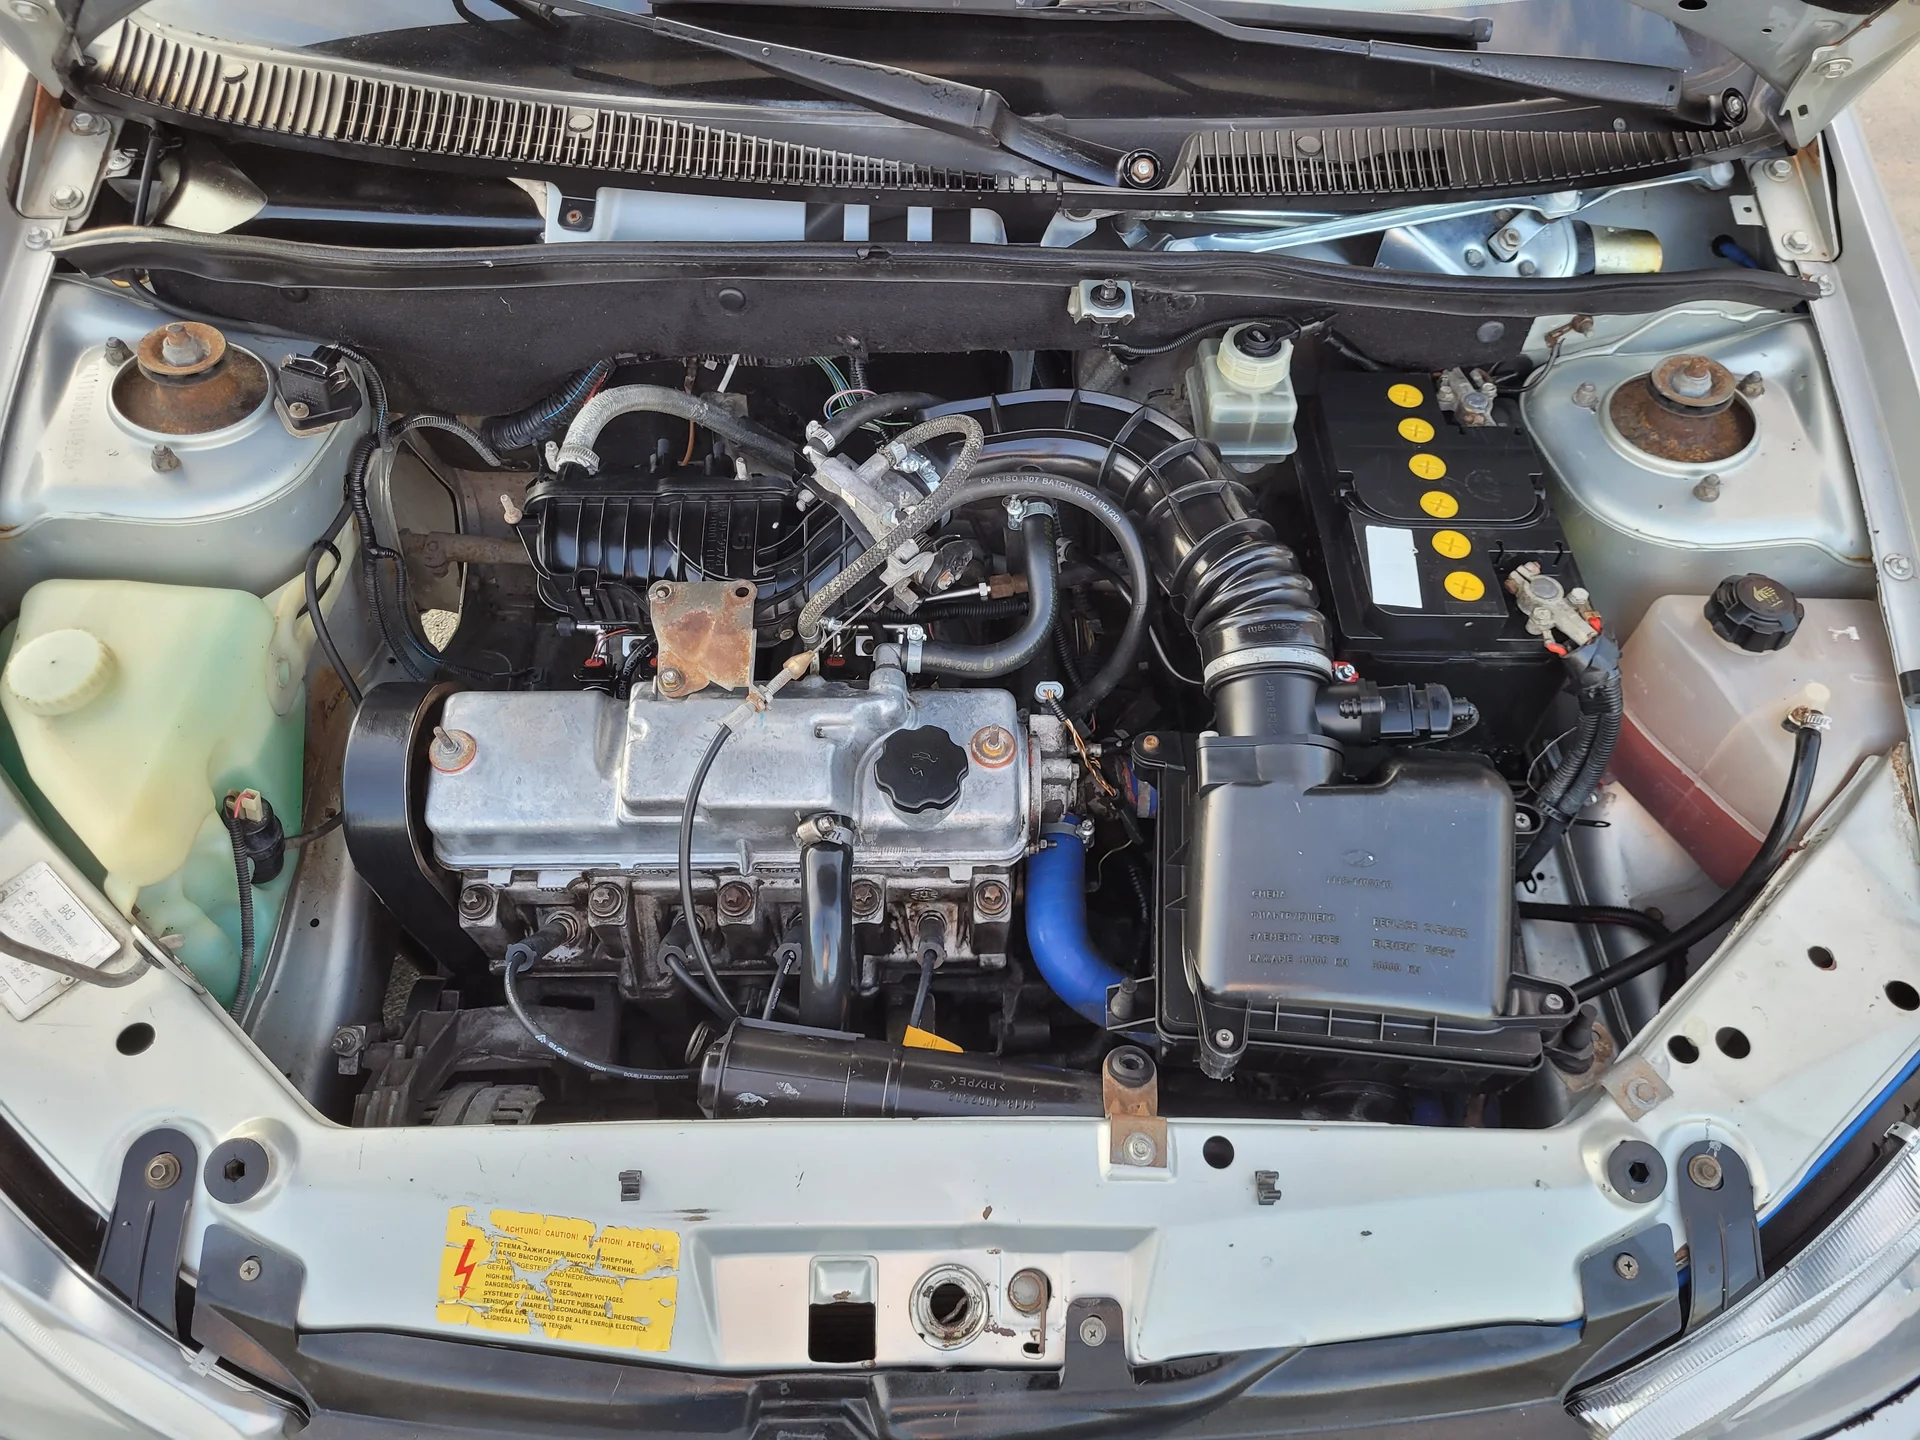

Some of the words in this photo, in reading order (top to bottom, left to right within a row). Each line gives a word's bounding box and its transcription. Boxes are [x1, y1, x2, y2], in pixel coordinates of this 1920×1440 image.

[1042, 477, 1073, 491] BATCH
[1074, 486, 1097, 501] 13027
[926, 656, 978, 671] 01.03.2024
[1251, 889, 1286, 899] СМЕНА
[1250, 911, 1336, 923] ФИЛЬТРУЮЩЕГО
[1372, 917, 1418, 931] REPLACE
[1249, 932, 1303, 942] ЭЛЕМЕНТА
[1309, 934, 1341, 945] ЧЕРЕЗ
[1372, 939, 1418, 953] ELEMENT
[951, 1075, 1006, 1091] >PP/PE<
[505, 1226, 541, 1236] ACHTUNG!
[545, 1230, 579, 1241] CAUTION!
[566, 1251, 597, 1261] ВЫСОКО
[601, 1255, 634, 1266] ЭНЕРГИИ.
[549, 1280, 574, 1289] SYSTEM.
[484, 1281, 521, 1290] DANGEROUS
[559, 1289, 594, 1299] SECONDARY
[594, 1294, 625, 1304] VOLTAGES.
[513, 1317, 528, 1325] ALTA
